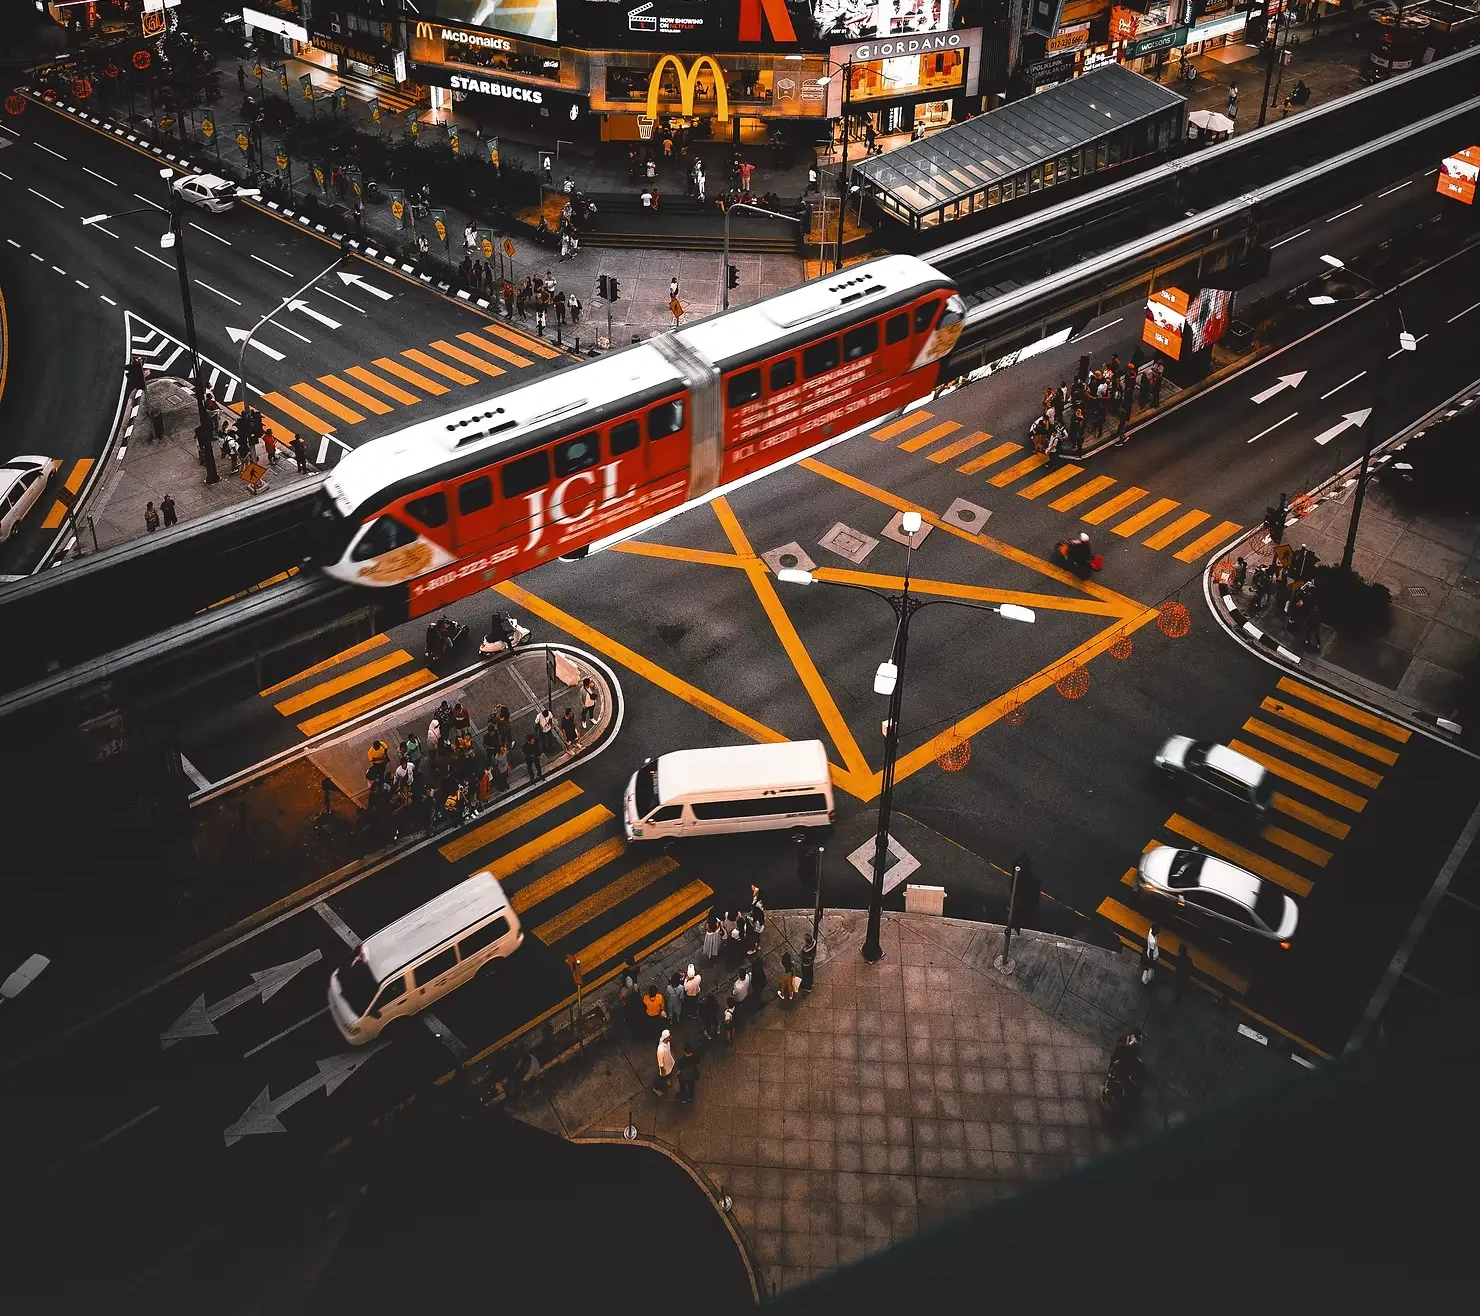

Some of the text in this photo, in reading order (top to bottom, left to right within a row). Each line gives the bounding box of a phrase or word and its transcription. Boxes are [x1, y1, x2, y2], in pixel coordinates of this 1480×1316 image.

[312, 36, 377, 64] HONEY BAKE
[441, 29, 511, 51] McDonald's
[856, 34, 960, 59] GIORDANO
[1141, 37, 1171, 51] watsons
[1032, 60, 1063, 73] POLIKLINIK
[450, 75, 543, 104] STARBUCKS
[802, 356, 872, 392] PERNIAGAAN
[758, 426, 799, 451] CREDIT
[800, 407, 845, 434] LEASING
[522, 459, 638, 552] JCL
